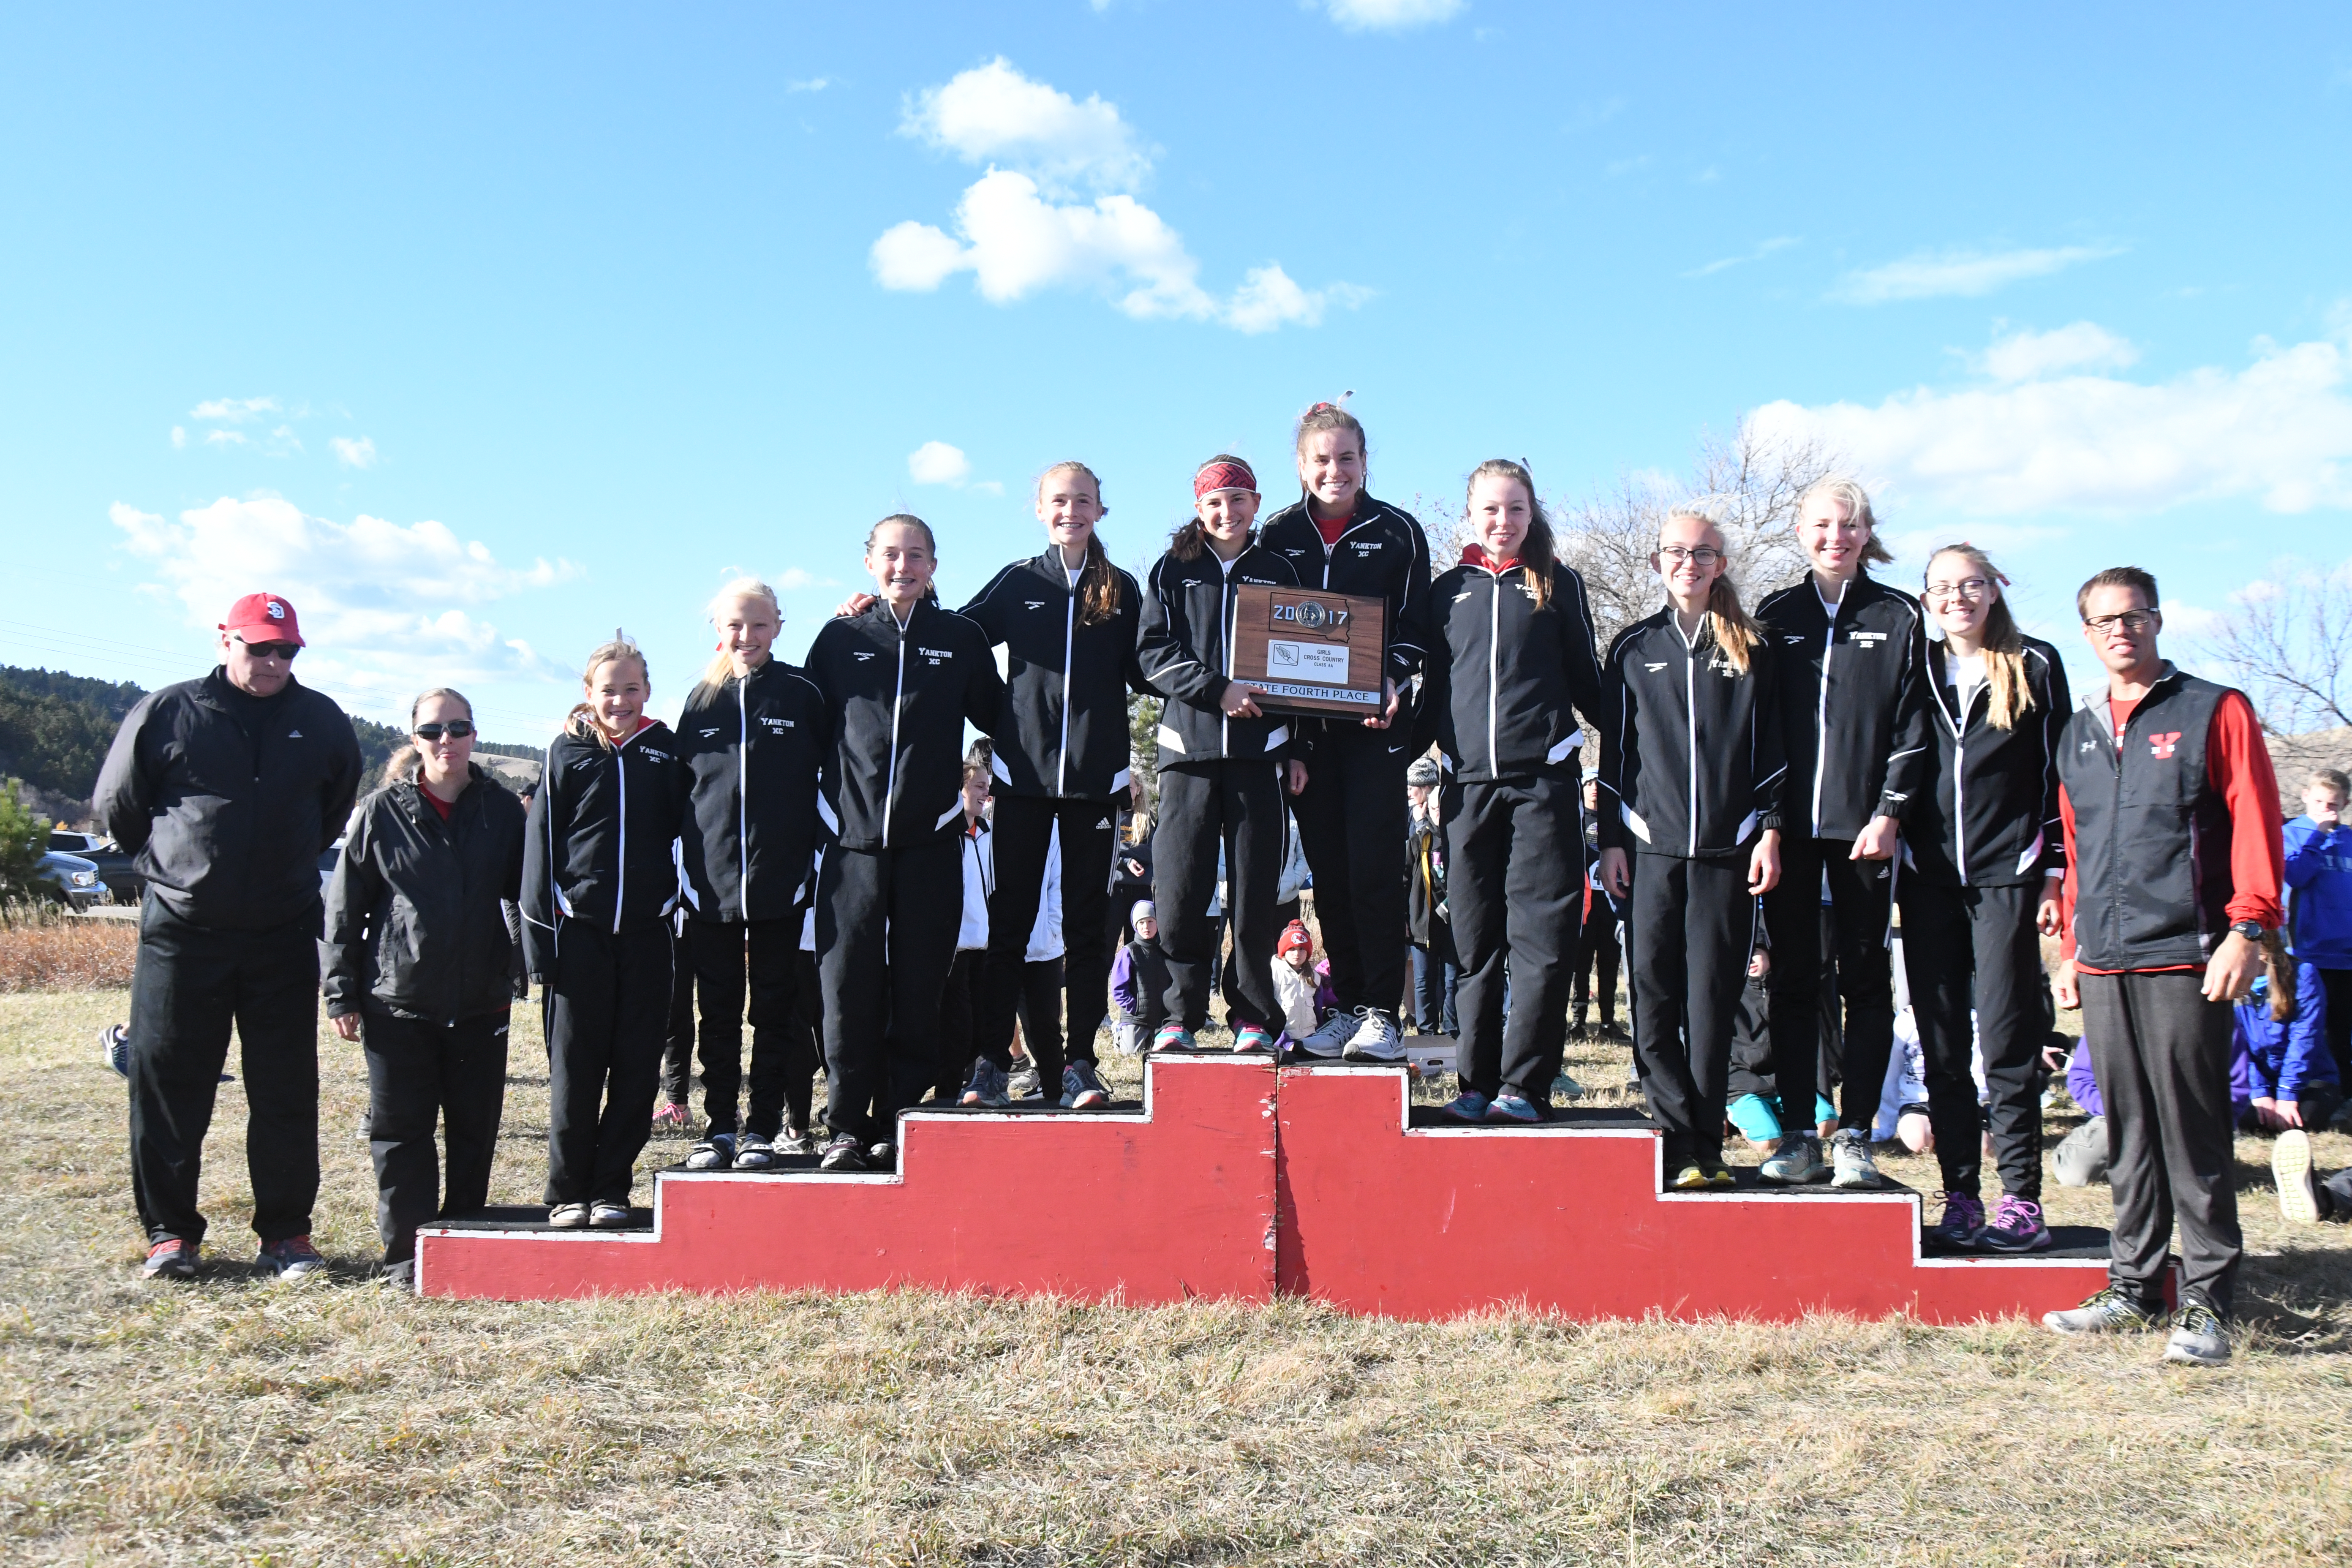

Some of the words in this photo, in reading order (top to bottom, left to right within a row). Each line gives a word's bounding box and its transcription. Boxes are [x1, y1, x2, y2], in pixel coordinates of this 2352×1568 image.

[918, 647, 953, 658] YANKTON
[1282, 685, 1329, 697] FOURTH
[1333, 690, 1369, 701] PLACE
[761, 718, 795, 727] YANKTON
